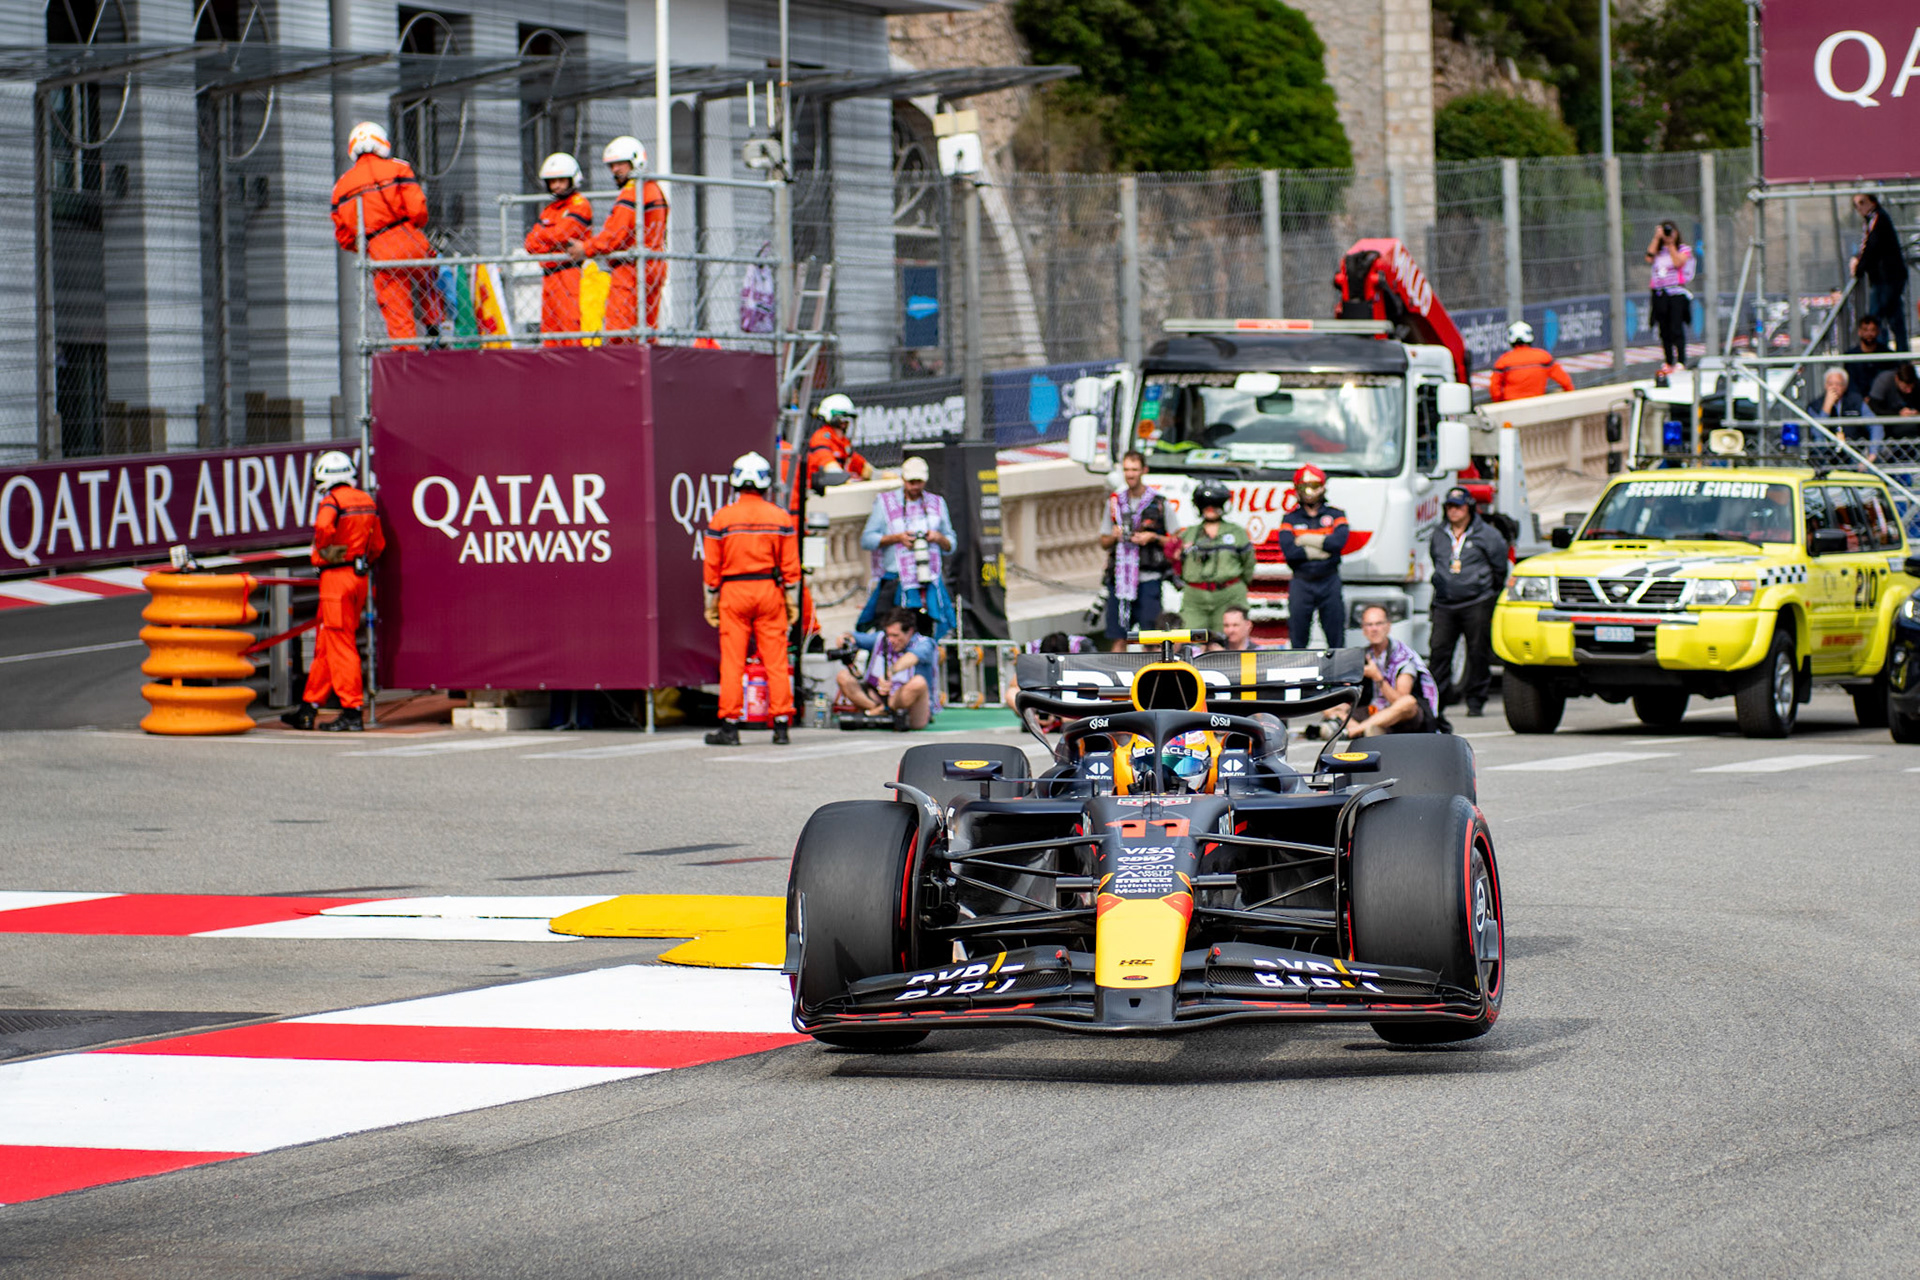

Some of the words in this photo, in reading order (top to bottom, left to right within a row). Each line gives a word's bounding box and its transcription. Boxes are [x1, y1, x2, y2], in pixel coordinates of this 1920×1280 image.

[1229, 486, 1300, 513] ILLO
[1701, 481, 1769, 499] CIRCUIT
[0, 464, 178, 567] QATAR
[188, 446, 378, 540] AIRW
[412, 473, 610, 539] QATAR
[670, 472, 742, 535] QAT
[458, 530, 612, 563] AIRWAYS
[1145, 747, 1192, 756] OACLE
[1104, 818, 1190, 838] 11
[1120, 846, 1176, 855] VISA
[1119, 958, 1155, 967] HRC
